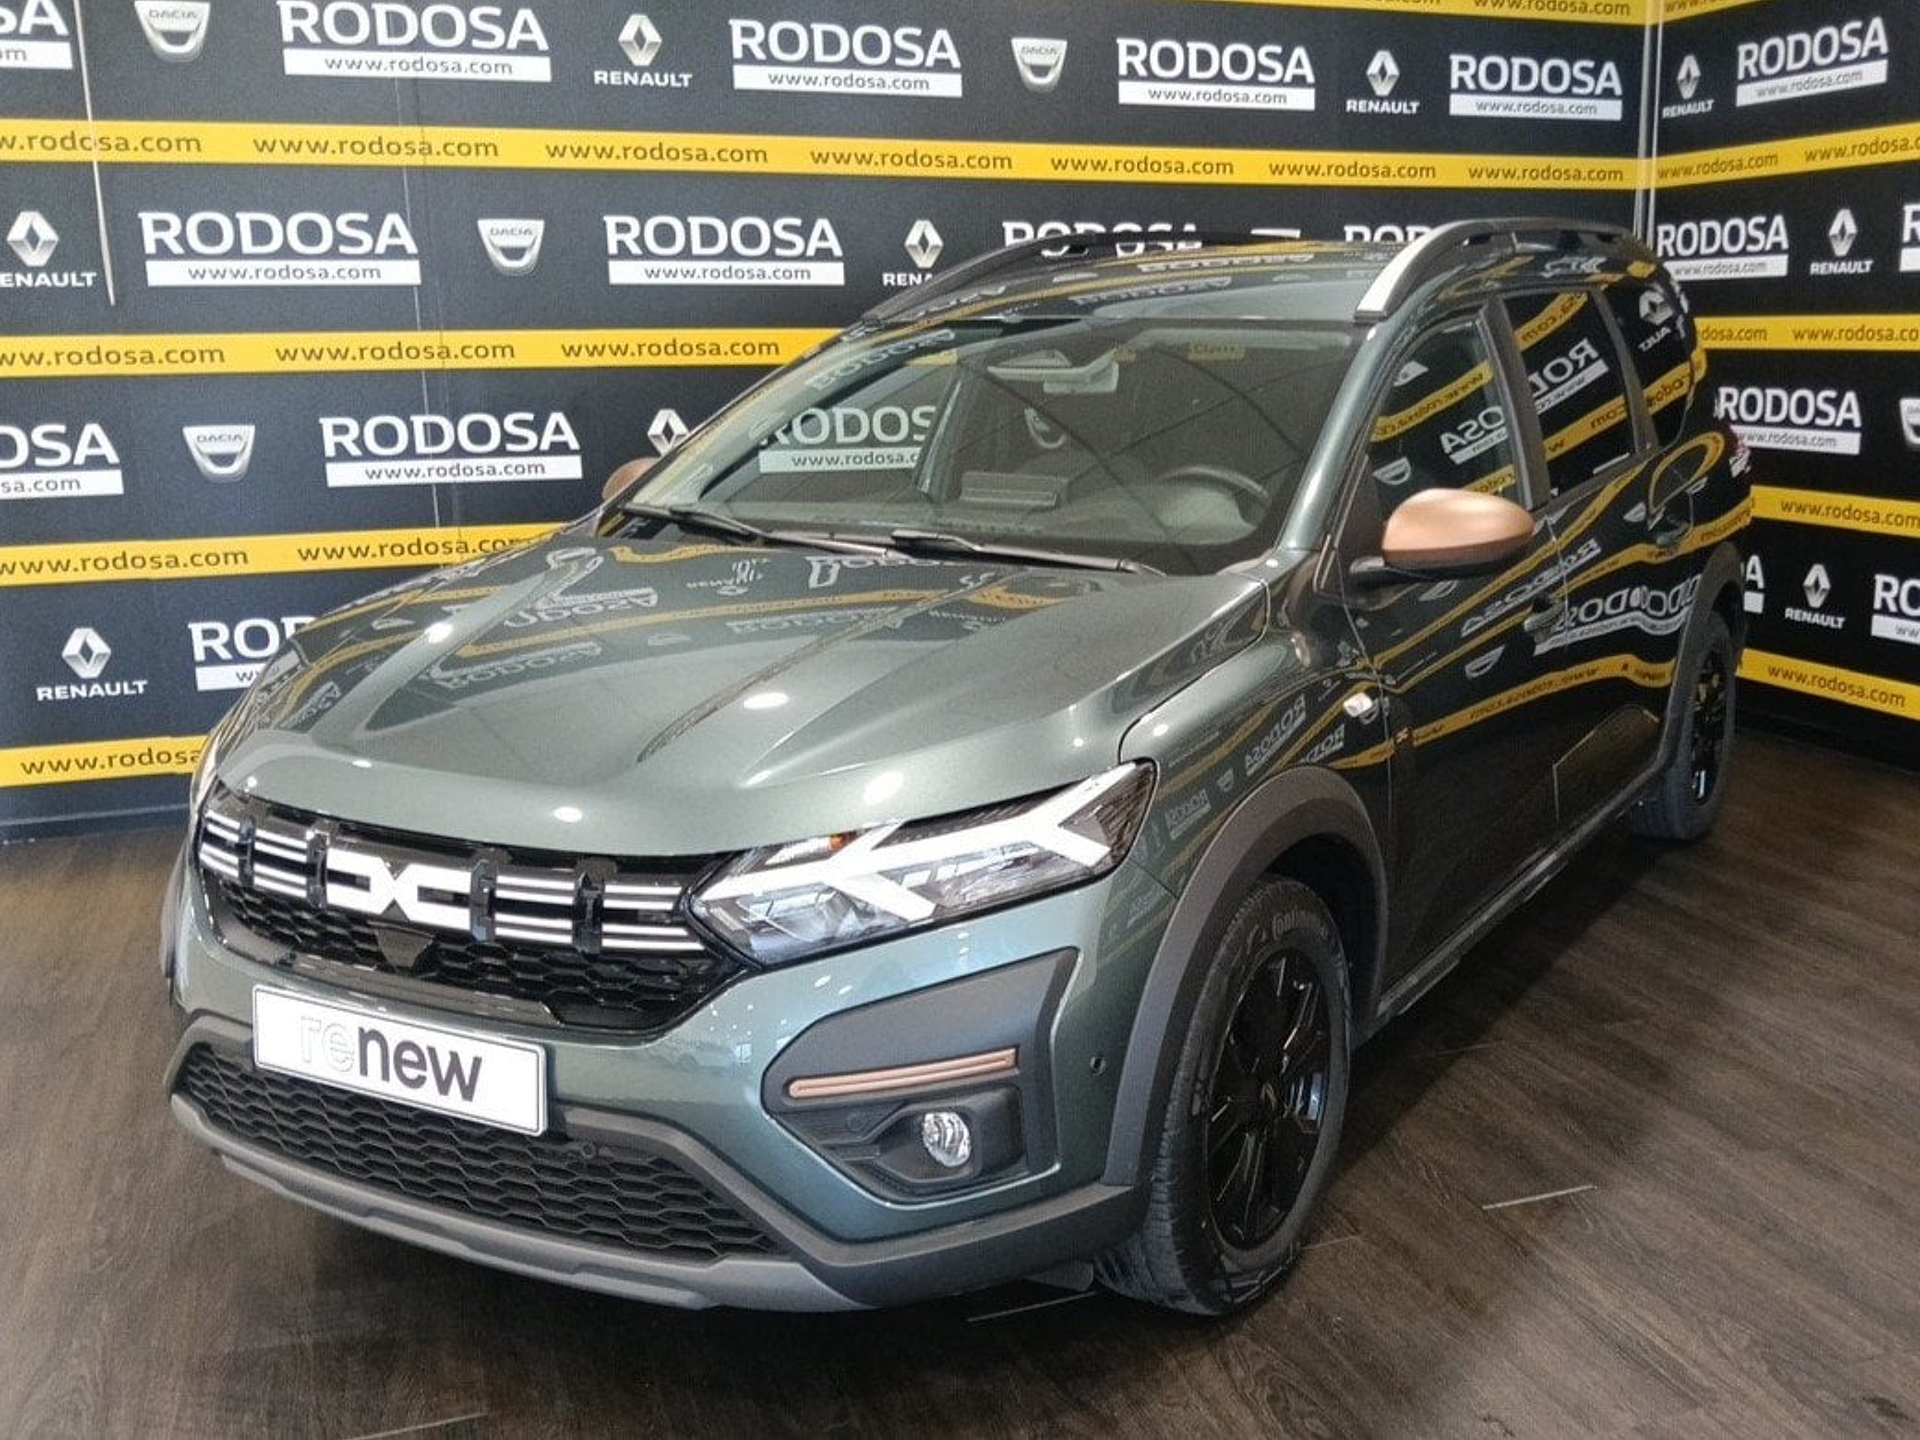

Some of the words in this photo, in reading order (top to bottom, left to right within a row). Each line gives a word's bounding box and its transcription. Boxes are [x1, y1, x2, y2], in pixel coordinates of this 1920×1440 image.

[277, 0, 549, 51] RODOSA
[729, 19, 961, 69] RODOSA
[1737, 16, 1889, 81] RODOSA
[325, 55, 513, 76] www.rodosa.com
[1117, 38, 1315, 85] RODOSA
[594, 71, 692, 88] RENAULT
[768, 72, 930, 91] www.rodosa.com
[1449, 54, 1622, 97] RODOSA
[1756, 69, 1863, 98] www.rodosa.com
[1148, 86, 1288, 105] www.rodosa.com
[1347, 98, 1419, 115] RENAULT
[1475, 98, 1597, 117] www.rodosa.com
[1662, 100, 1715, 118] RENAULT
[254, 136, 499, 158] www.rodosa.com
[546, 142, 768, 163] www.rodosa.com
[811, 149, 1013, 171] www.rodosa.com
[1051, 155, 1234, 176] www.rodosa.com
[1268, 159, 1437, 180] www.rodosa.com
[1658, 152, 1778, 180] www.rodosa.com
[1468, 163, 1624, 183] www.rodosa.com
[139, 212, 418, 255] RODOSA
[604, 215, 844, 257] RODOSA
[1657, 214, 1789, 257] RODOSA
[188, 264, 382, 281] www.rodosa.com
[644, 264, 811, 281] www.rodosa.com
[1810, 260, 1874, 275] RENAULT
[275, 340, 515, 362] www.rodosa.com
[561, 337, 780, 359] www.rodosa.com
[1717, 387, 1862, 428] RODOSA
[319, 412, 580, 457] RODOSA
[365, 459, 546, 480] www.rodosa.com
[1, 477, 81, 493] sa.com
[1781, 499, 1920, 530] www.rodosa.com
[1785, 606, 1847, 629] RENAULT
[37, 680, 148, 701] RENAULT
[1767, 663, 1907, 708] www.rodosa.com
[300, 1013, 482, 1102] renew
